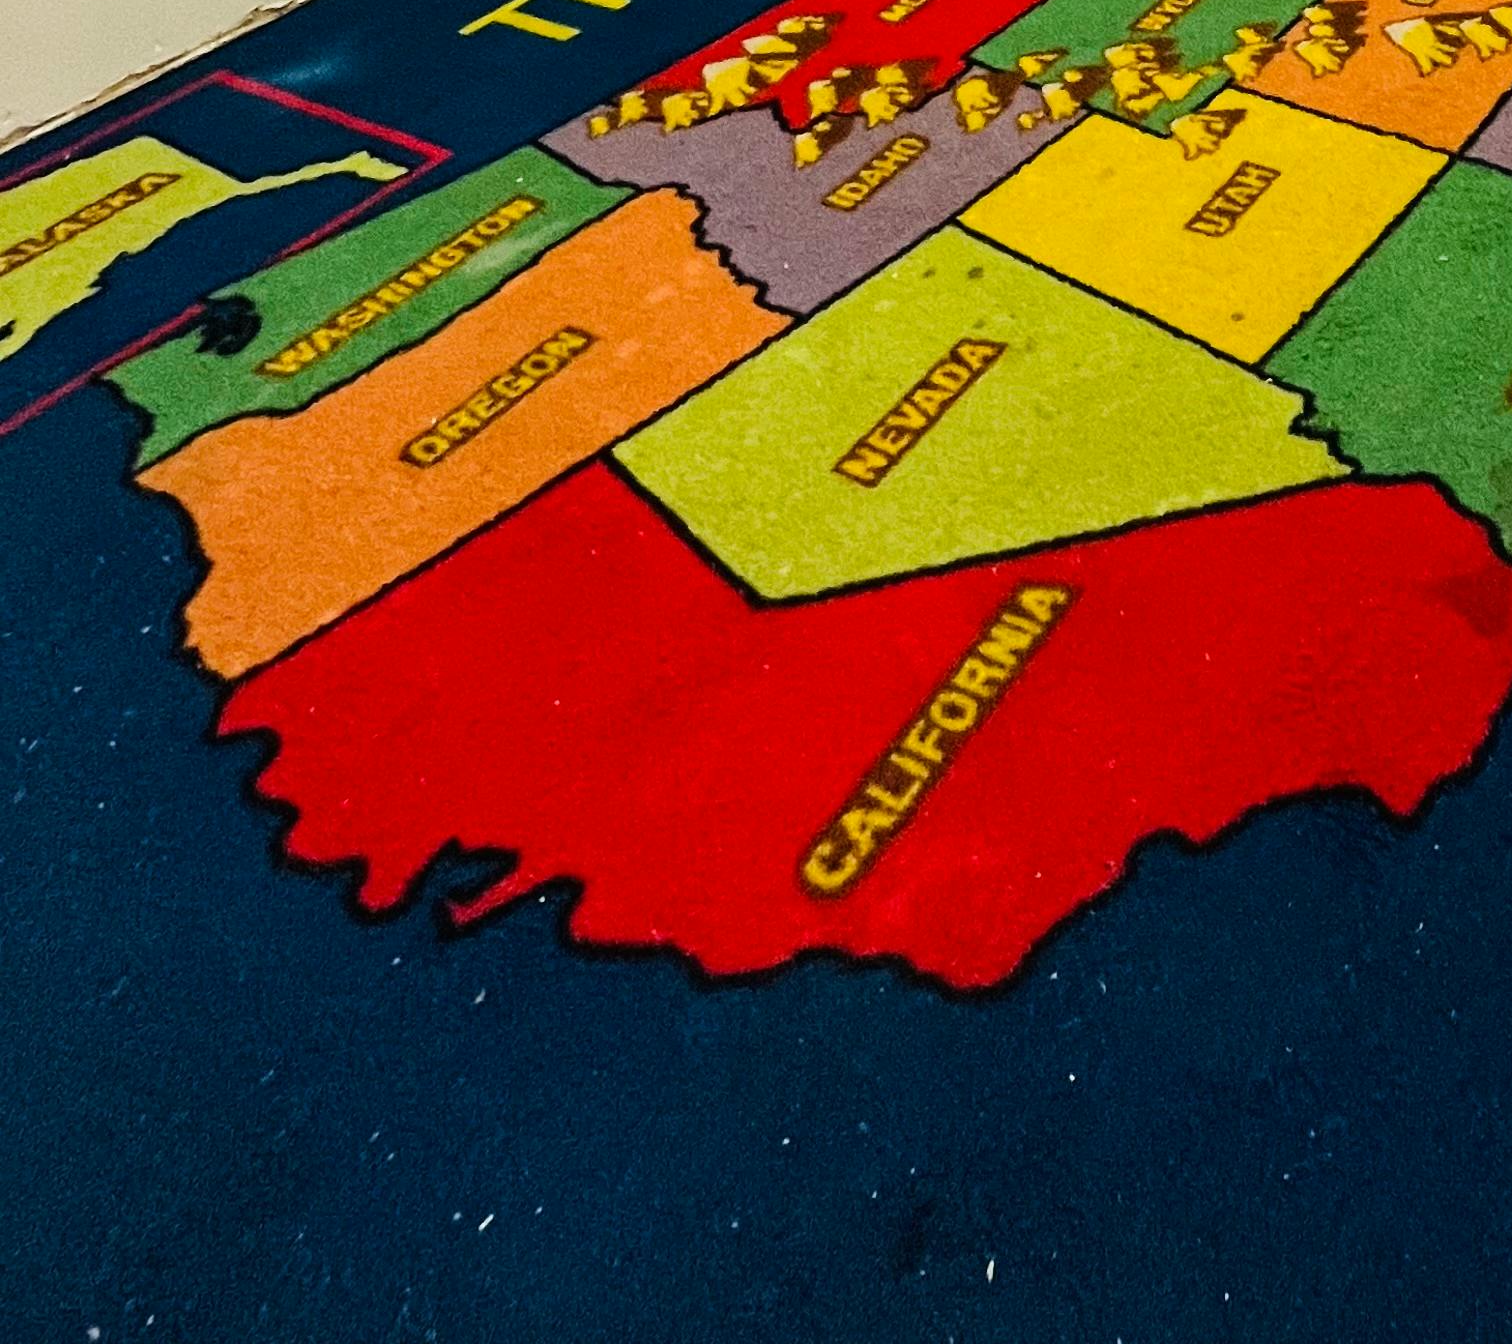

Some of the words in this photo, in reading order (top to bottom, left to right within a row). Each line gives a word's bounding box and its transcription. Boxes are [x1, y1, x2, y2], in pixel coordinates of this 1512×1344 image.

[823, 136, 930, 210] IDAHO
[1186, 162, 1281, 237] UTAH
[257, 195, 545, 377] WASHINGTON
[403, 327, 598, 466] OREGON
[834, 339, 1007, 487] NEVADA
[801, 582, 1075, 894] CALIFORNIA
